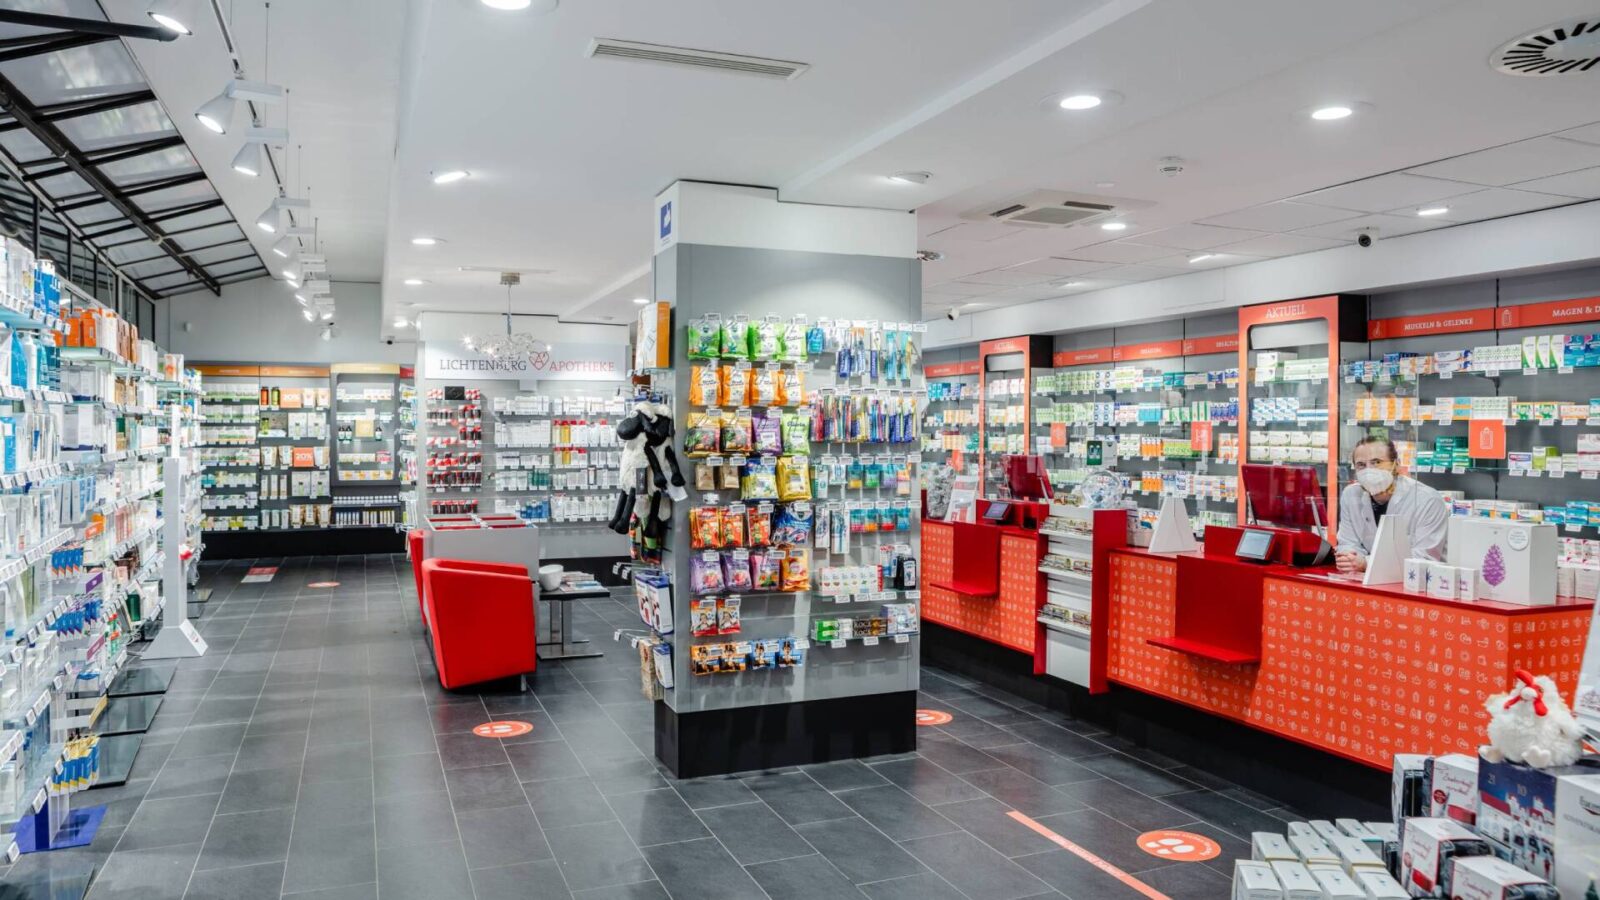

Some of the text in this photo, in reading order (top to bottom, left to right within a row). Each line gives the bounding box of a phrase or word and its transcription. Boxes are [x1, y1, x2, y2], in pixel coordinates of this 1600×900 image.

[1265, 304, 1306, 319] AKTUELL
[1552, 308, 1583, 318] MAGEN
[1585, 306, 1592, 314] &
[1404, 322, 1435, 331] MUSKELN
[1443, 318, 1473, 327] GELENKE
[439, 359, 527, 371] LICHTENBERG
[549, 361, 614, 373] APOTHEKE
